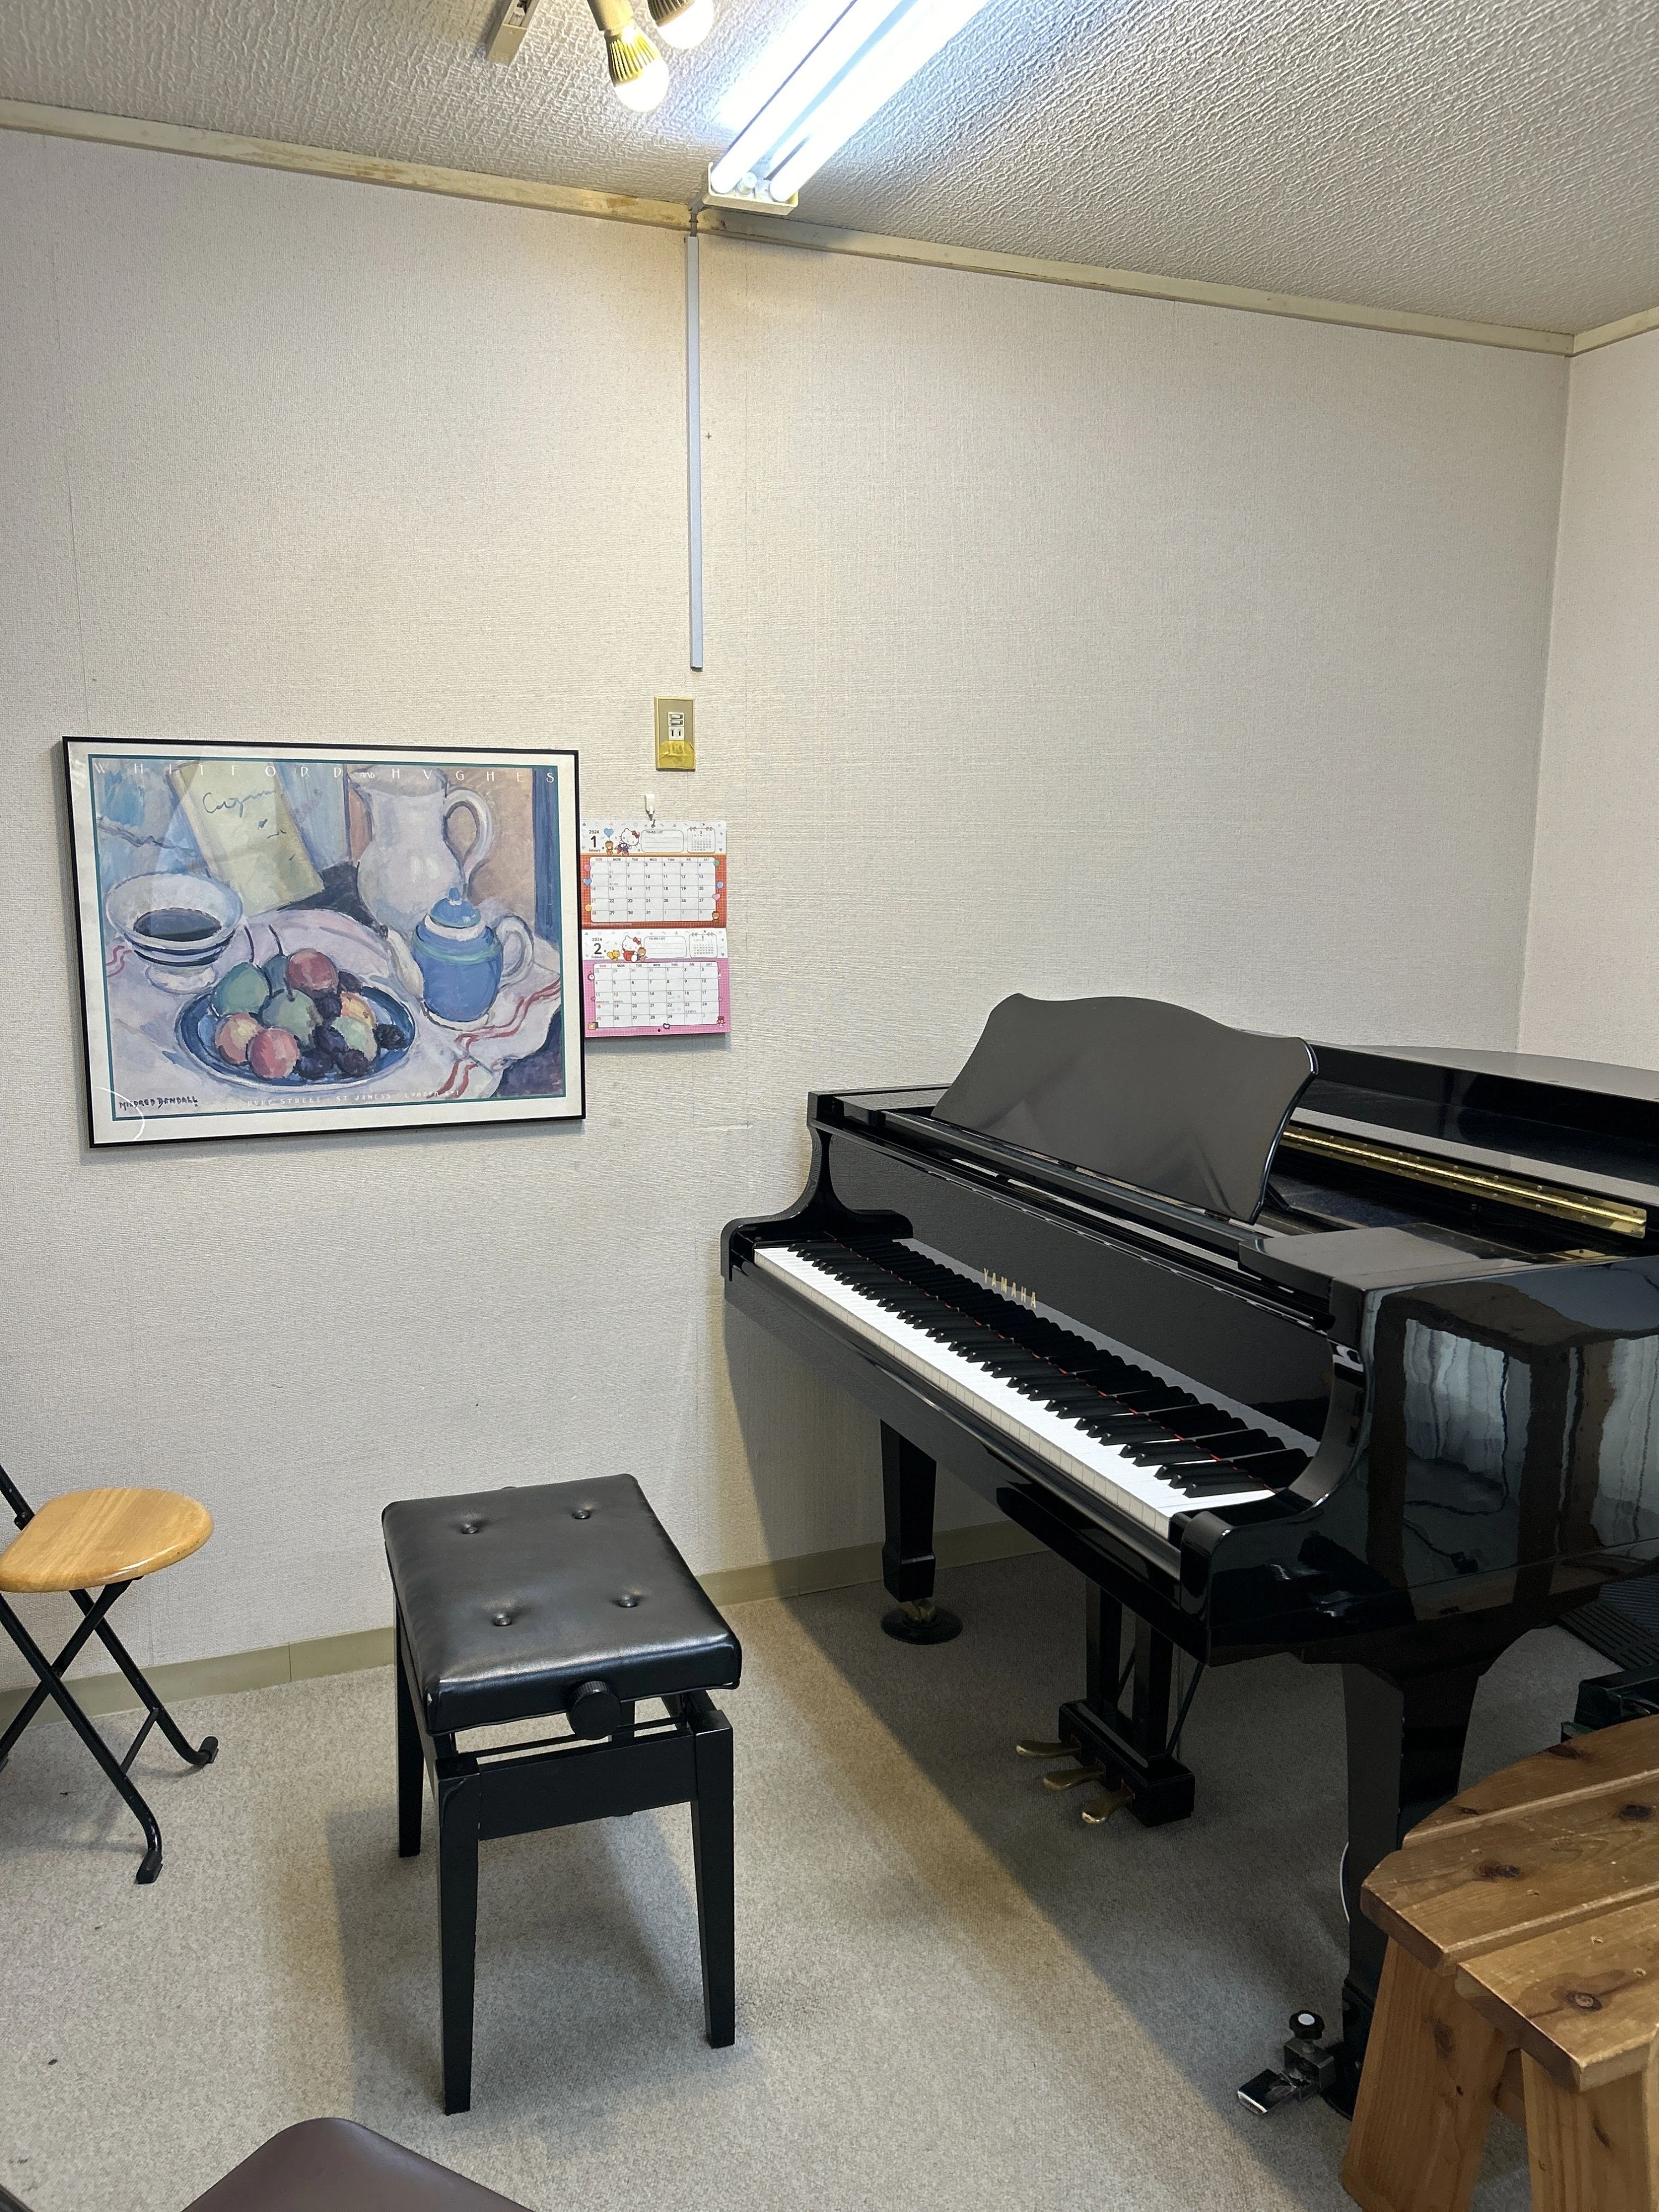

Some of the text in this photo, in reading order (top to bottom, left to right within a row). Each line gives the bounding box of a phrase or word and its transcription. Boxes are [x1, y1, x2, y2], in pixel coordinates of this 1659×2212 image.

[591, 836, 596, 848] 1
[593, 943, 602, 954] 2
[983, 1267, 1036, 1308] YAMAHA
